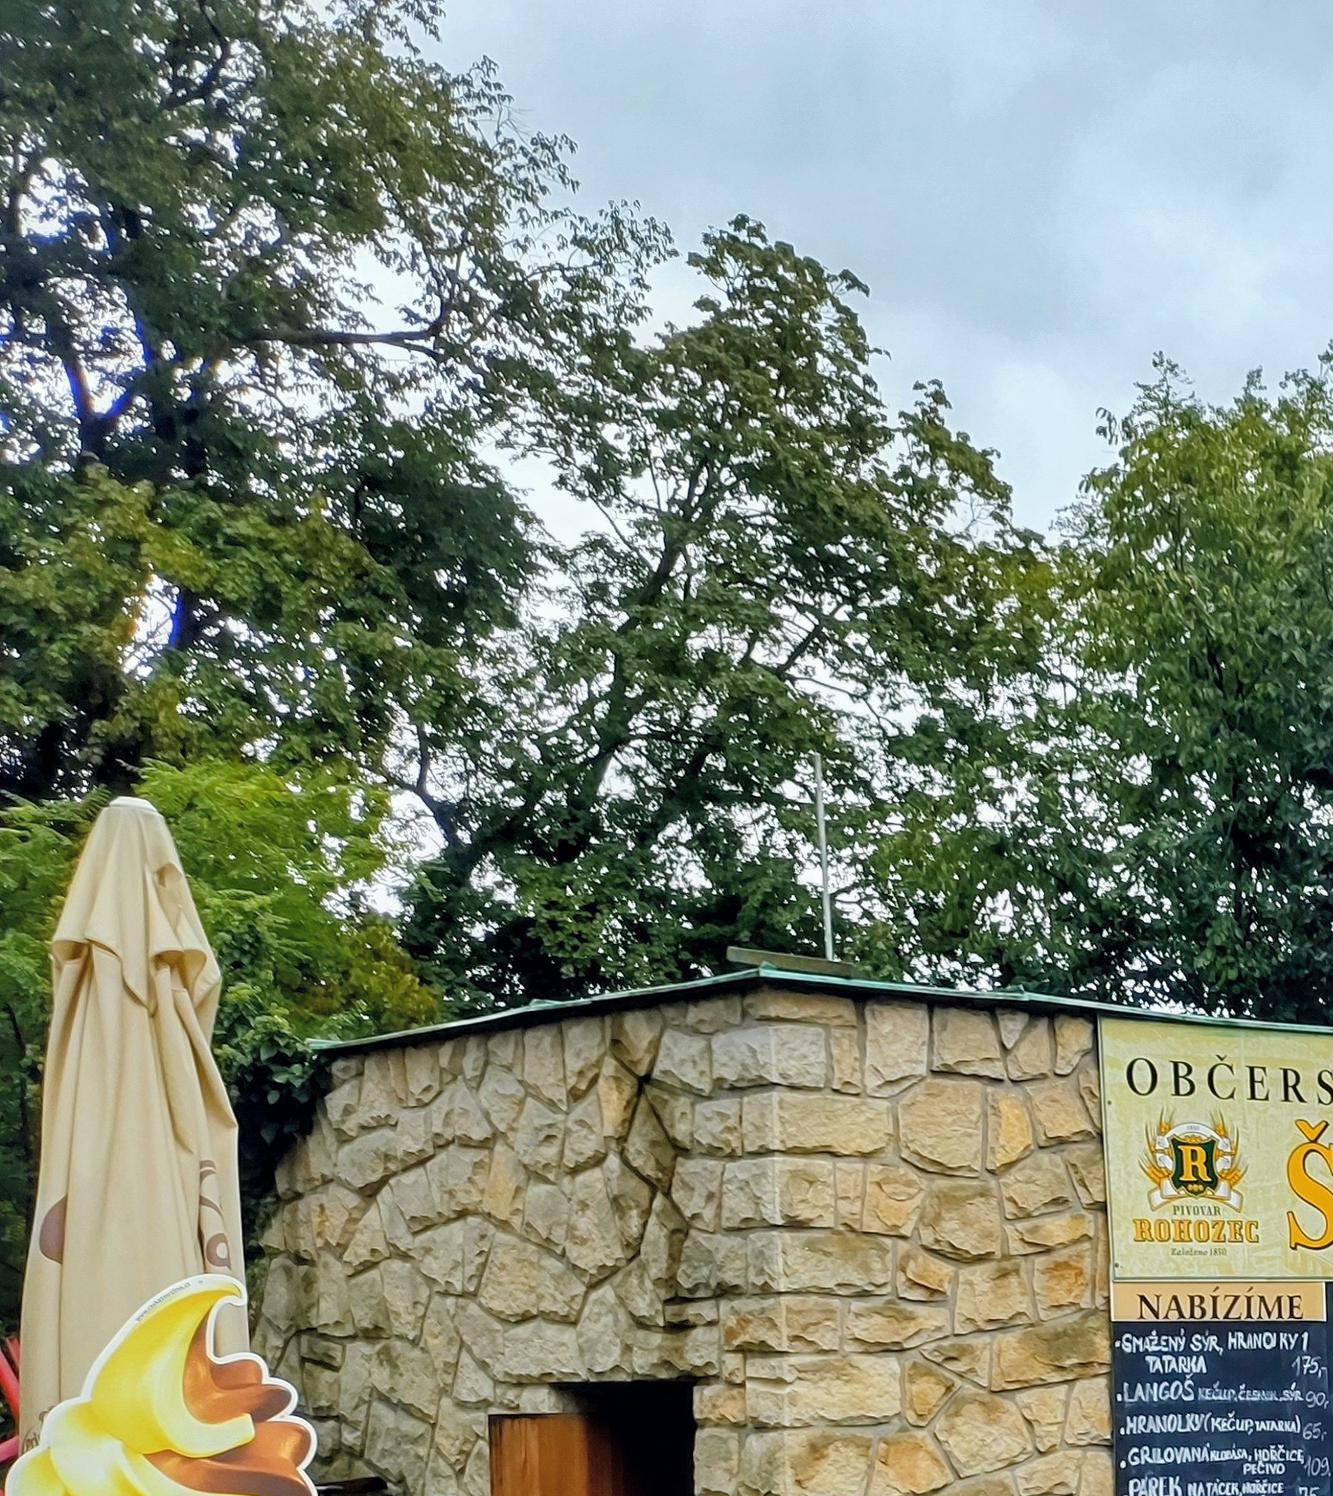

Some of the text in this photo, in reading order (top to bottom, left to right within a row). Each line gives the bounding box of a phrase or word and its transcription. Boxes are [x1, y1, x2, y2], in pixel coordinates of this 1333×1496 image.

[1177, 1145, 1212, 1182] R
[1173, 1205, 1221, 1216] PIVOVAR
[1133, 1219, 1259, 1243] ROHOZEC
[1137, 1286, 1304, 1320] NABÍZÍME
[1145, 1355, 1207, 1374] TATARKA
[1123, 1373, 1194, 1401] LANGOŠ
